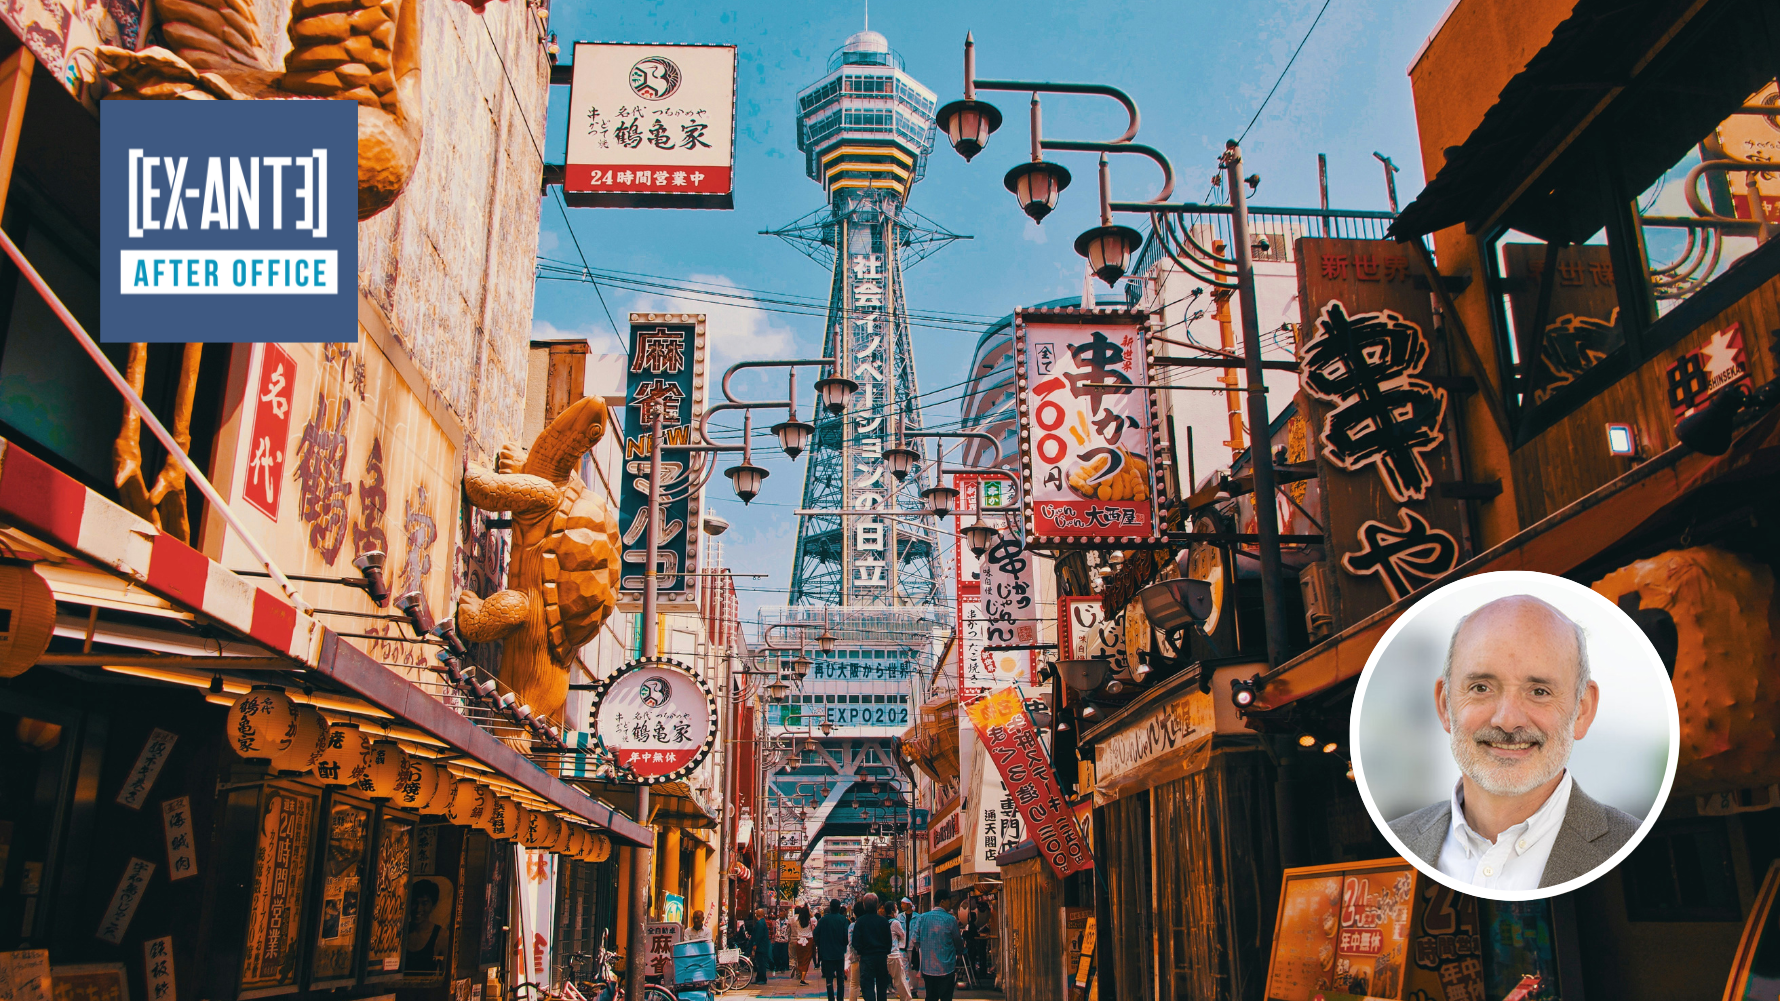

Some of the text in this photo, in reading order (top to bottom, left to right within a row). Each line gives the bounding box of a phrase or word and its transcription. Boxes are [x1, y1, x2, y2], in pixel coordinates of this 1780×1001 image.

[587, 105, 600, 137] 串かつ
[615, 106, 647, 118] 名代
[614, 117, 713, 150] 鶴亀家
[590, 169, 705, 187] 24時間営業中
[1321, 254, 1411, 284] 新世界
[1038, 345, 1053, 373] 全て
[1121, 334, 1133, 373] 新世界
[629, 327, 686, 426] 麻雀
[853, 254, 887, 586] 社会イノベーションの日立
[1063, 330, 1140, 486] 串かつ
[250, 362, 290, 504] 名代
[626, 424, 692, 460] NW
[1085, 505, 1143, 529] 大西屋
[983, 566, 994, 596] 味自慢
[967, 609, 980, 685] 串かつ たこ焼き
[237, 695, 261, 753] 鶴亀家
[827, 707, 908, 724] EXPO202
[631, 720, 694, 744] 鶴亀家
[630, 751, 677, 763] 年中無休
[984, 809, 997, 861] 通天閣店
[264, 811, 296, 959] 24時間営業
[1340, 931, 1382, 953] 年中無休
[1440, 957, 1481, 983] 年中
